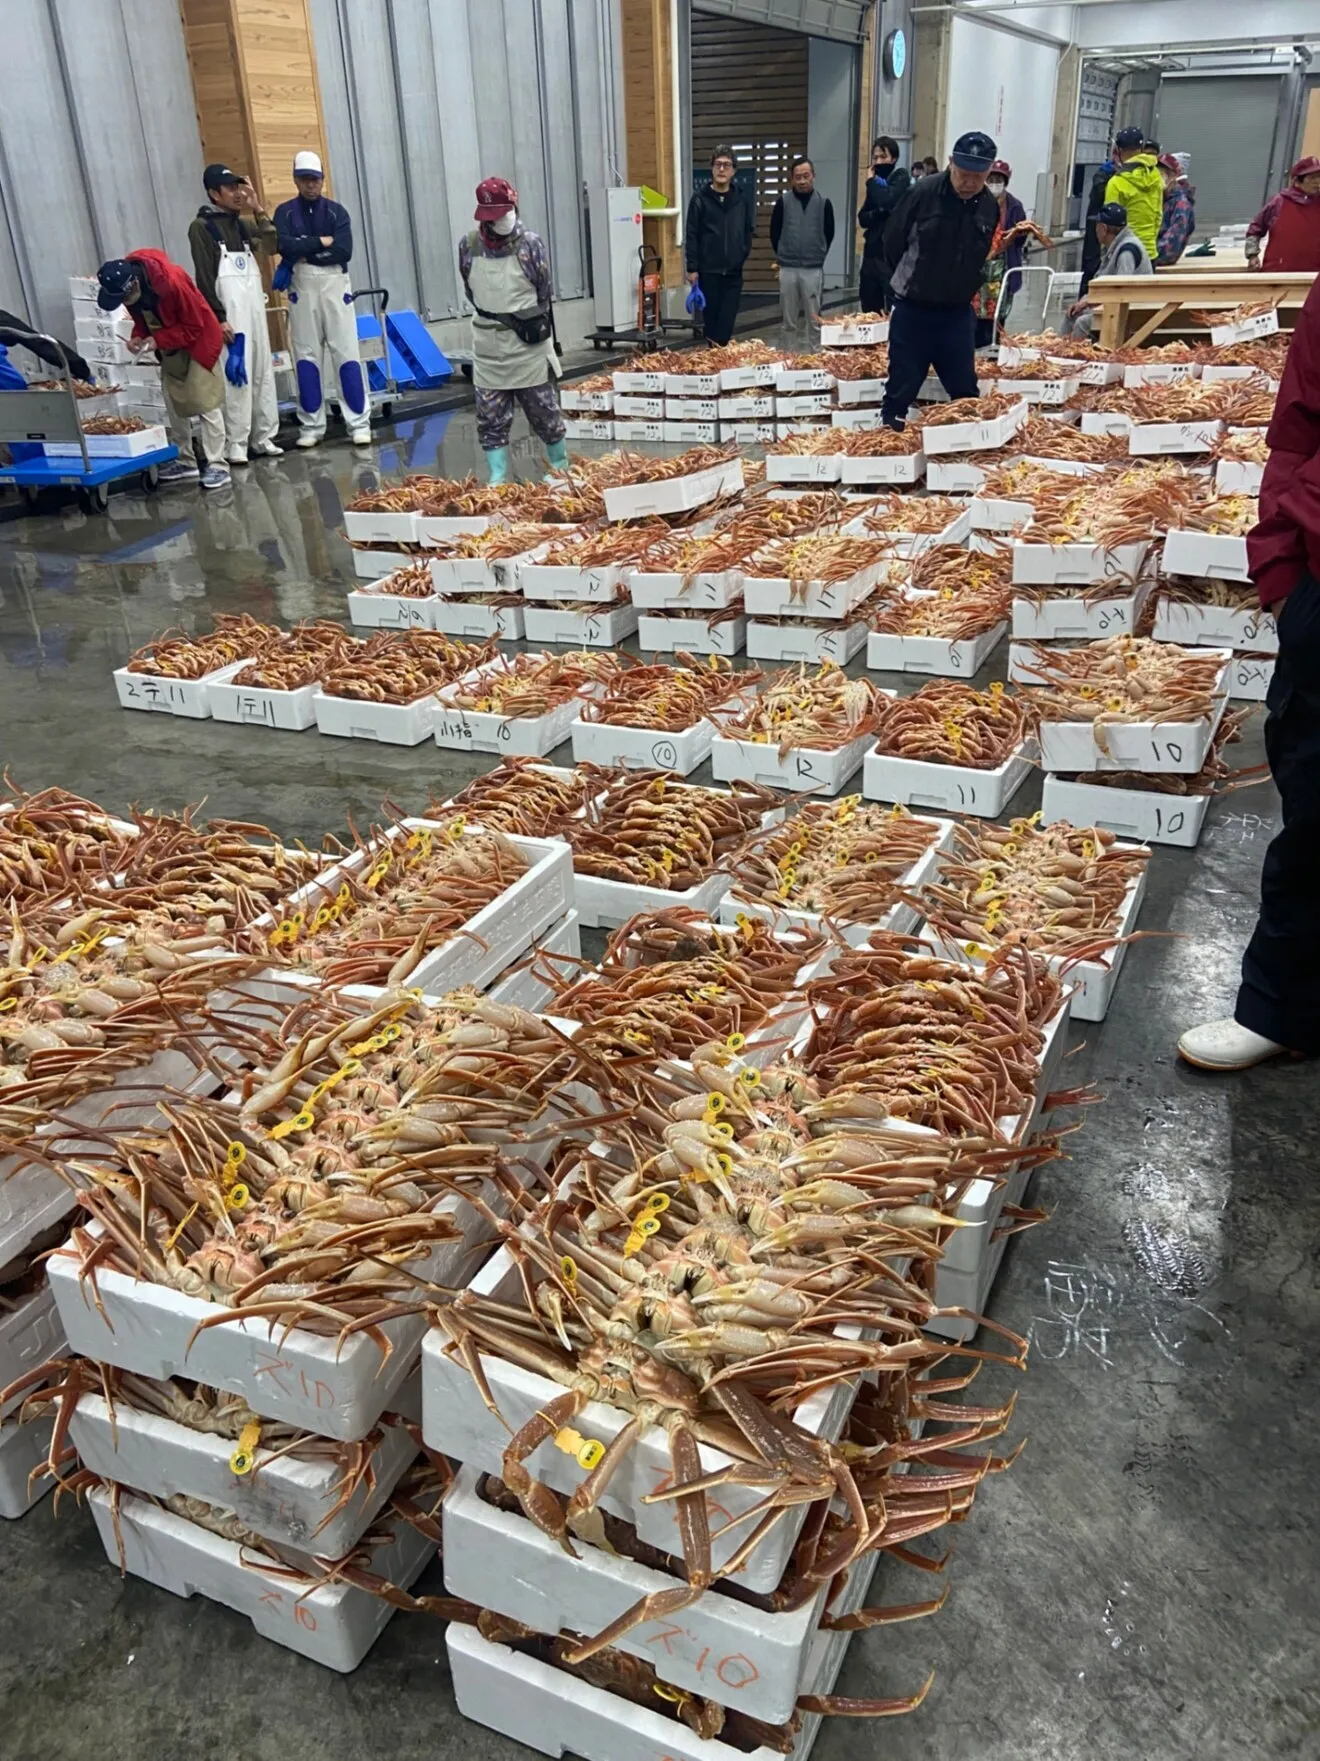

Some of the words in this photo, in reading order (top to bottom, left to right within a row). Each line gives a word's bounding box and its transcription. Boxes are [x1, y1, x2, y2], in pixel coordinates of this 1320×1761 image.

[980, 428, 989, 442] 11
[815, 462, 828, 476] 12
[893, 463, 907, 476] 12
[496, 724, 512, 741] 10
[1151, 740, 1183, 763] 10
[957, 784, 976, 805] 11
[1155, 807, 1185, 837] 10
